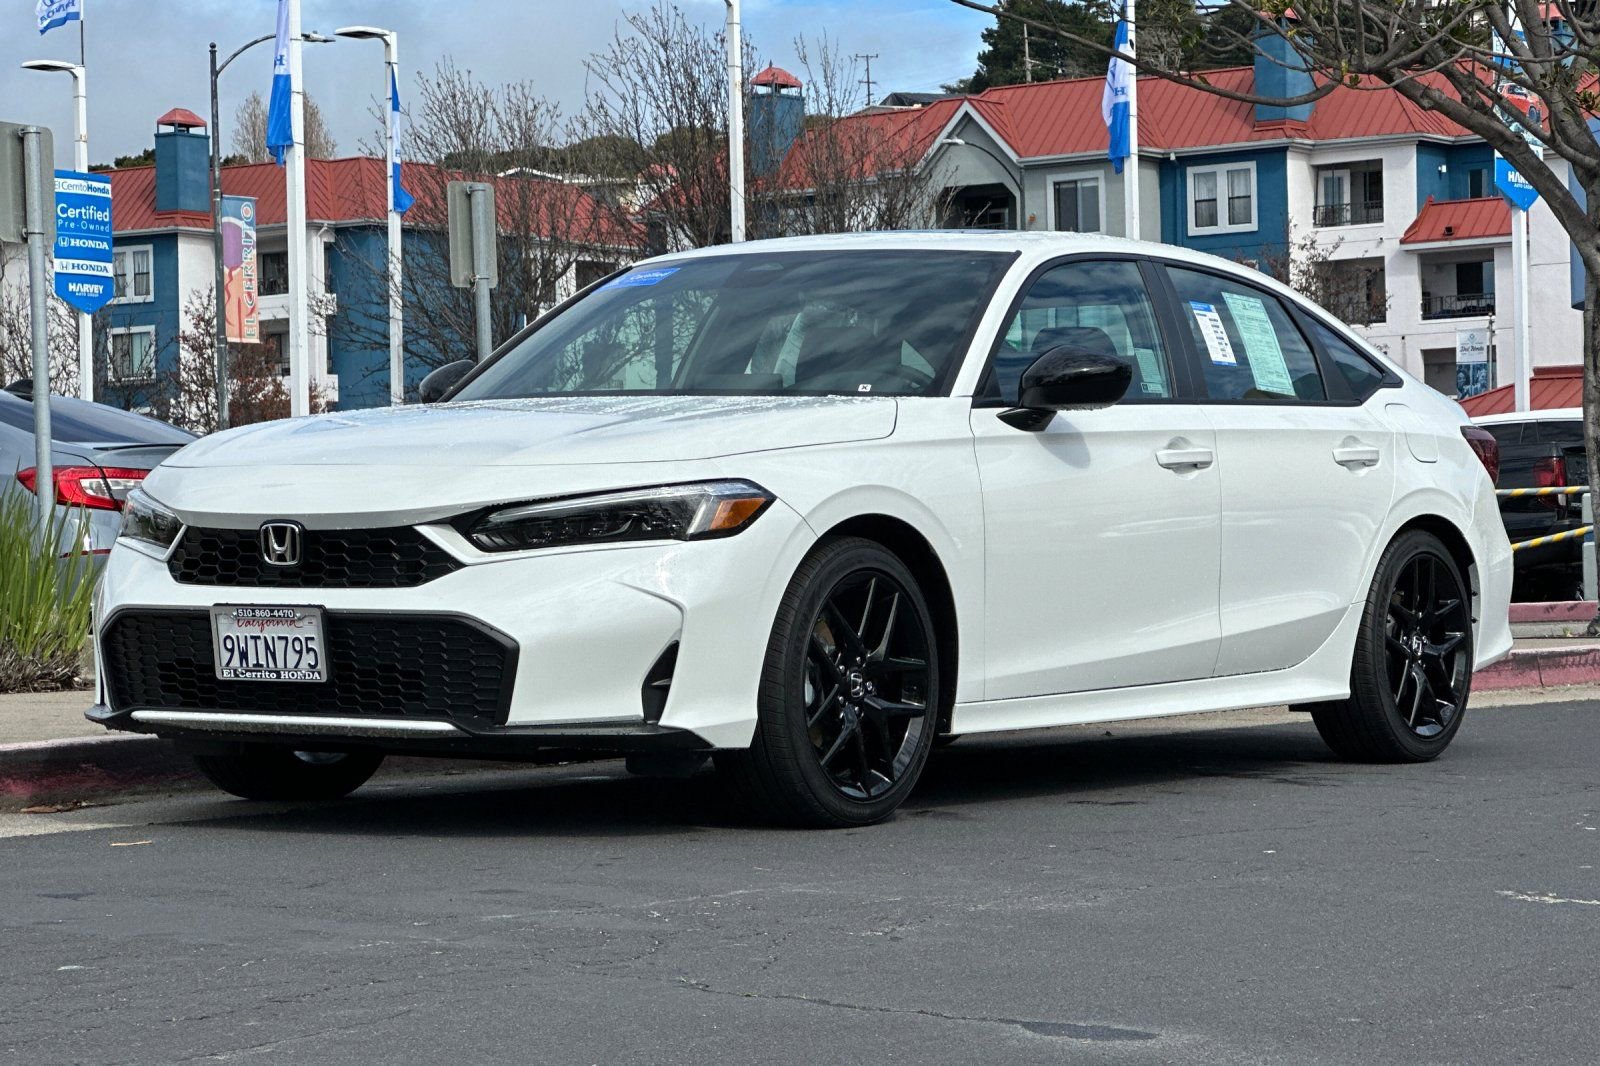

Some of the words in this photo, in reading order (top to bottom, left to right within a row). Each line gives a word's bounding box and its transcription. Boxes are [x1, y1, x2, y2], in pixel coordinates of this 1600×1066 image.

[57, 203, 110, 222] Certified
[58, 219, 110, 232] Pre-Owned
[70, 238, 109, 250] HONDA
[241, 202, 254, 306] CERRITO
[71, 263, 109, 273] HONDA
[68, 282, 104, 294] HARVEY
[246, 315, 256, 337] EL
[238, 609, 294, 618] 510-860-4470
[237, 618, 303, 632] California
[223, 635, 319, 669] 9WIN795
[223, 669, 234, 678] El
[238, 669, 277, 679] Cerrito
[280, 670, 320, 680] HONDA
